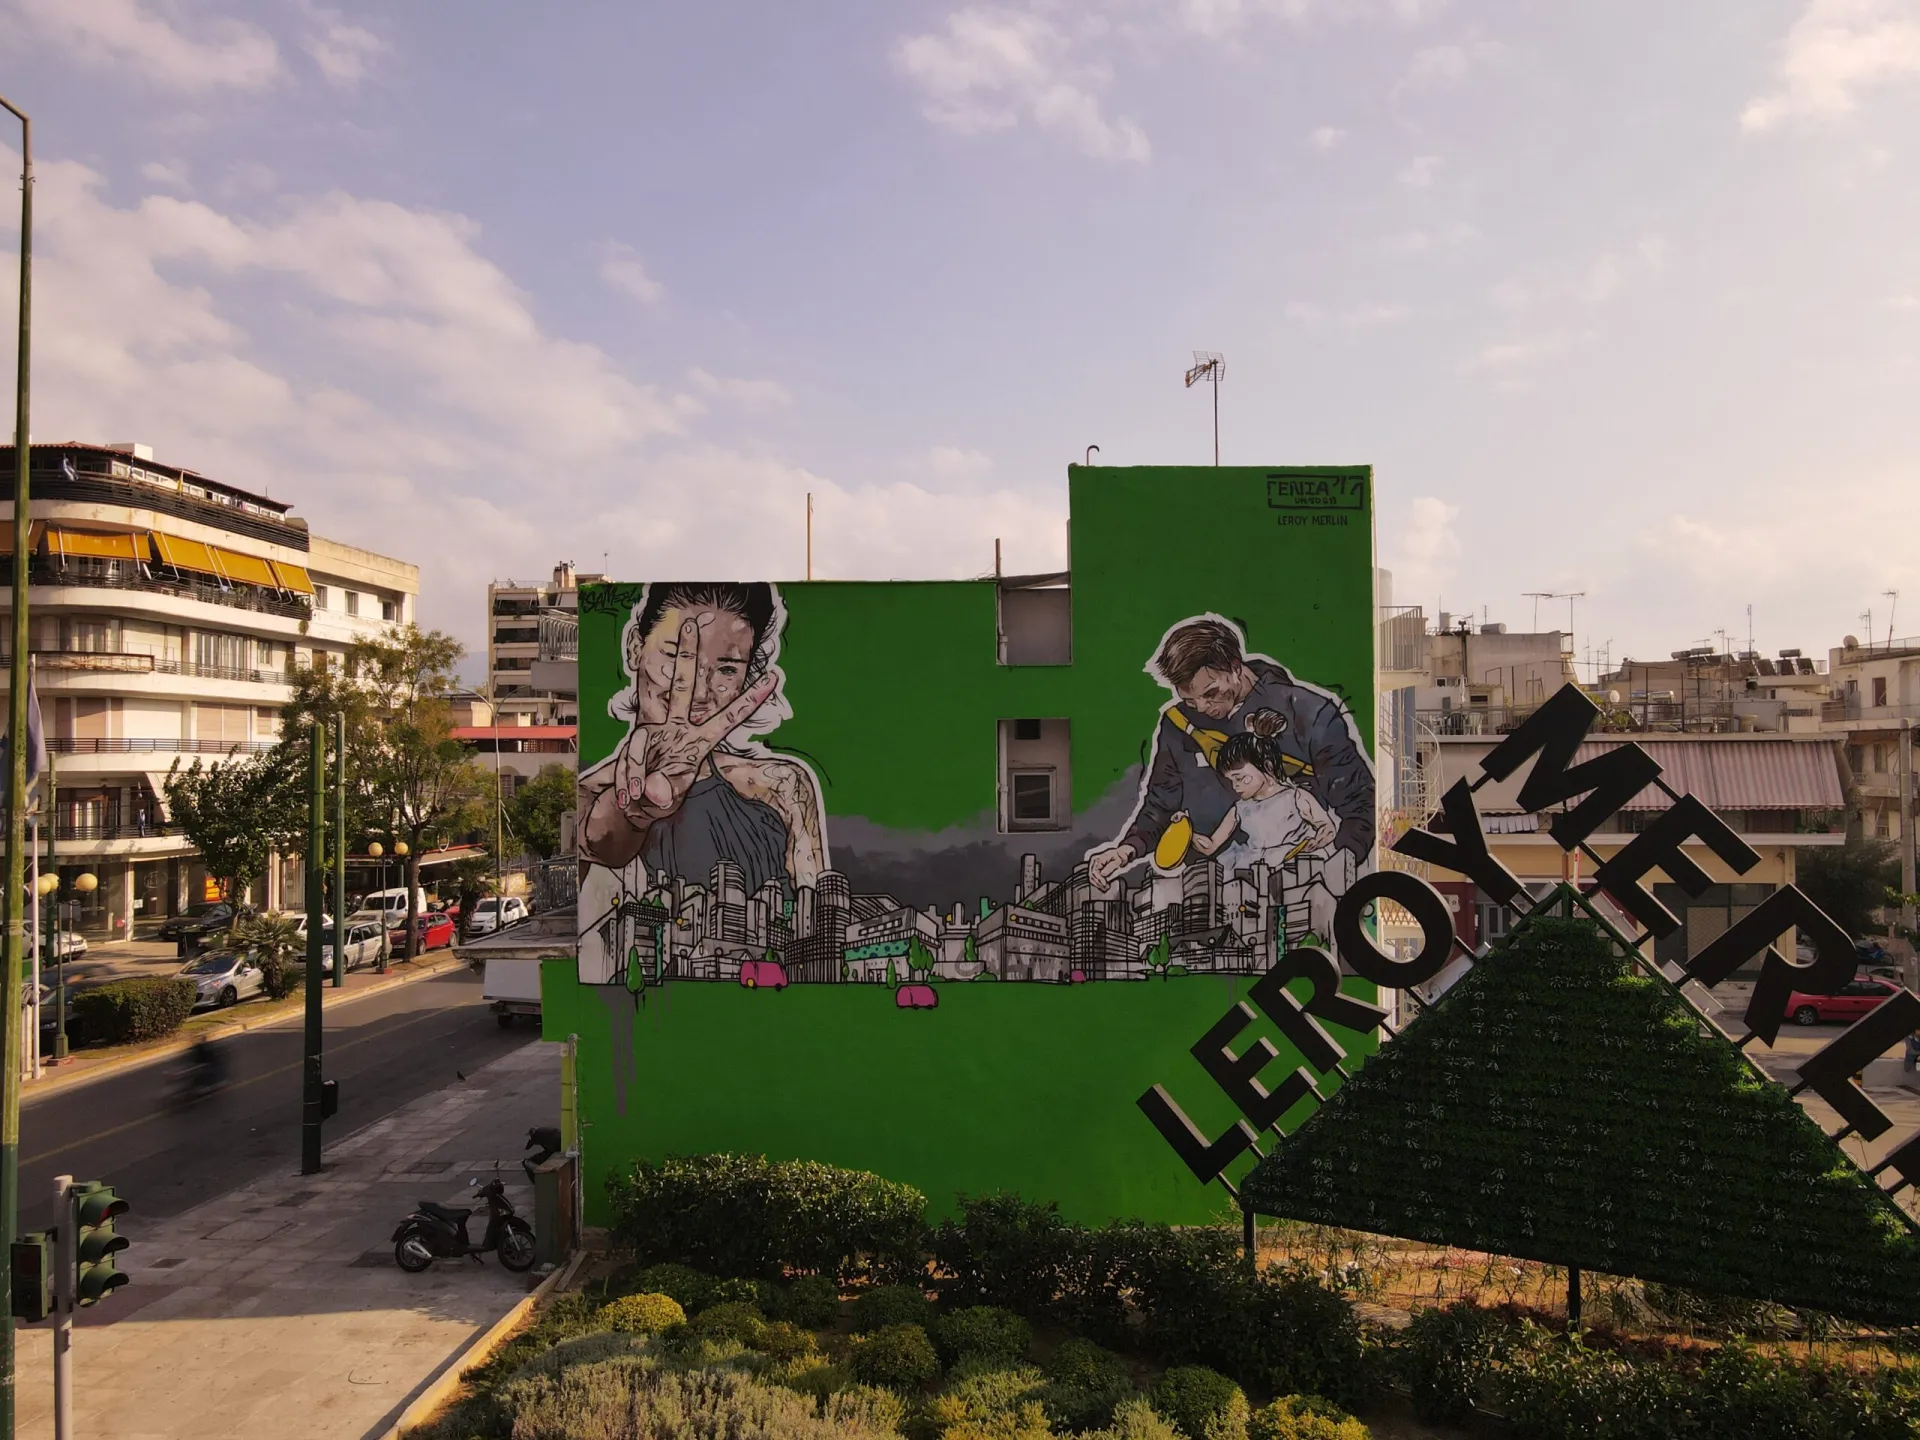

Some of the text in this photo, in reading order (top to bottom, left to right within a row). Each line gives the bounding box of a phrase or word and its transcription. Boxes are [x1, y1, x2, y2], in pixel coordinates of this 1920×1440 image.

[1277, 515, 1348, 526] LEROY MERLIN
[1135, 681, 1920, 1188] LEROY MERL
